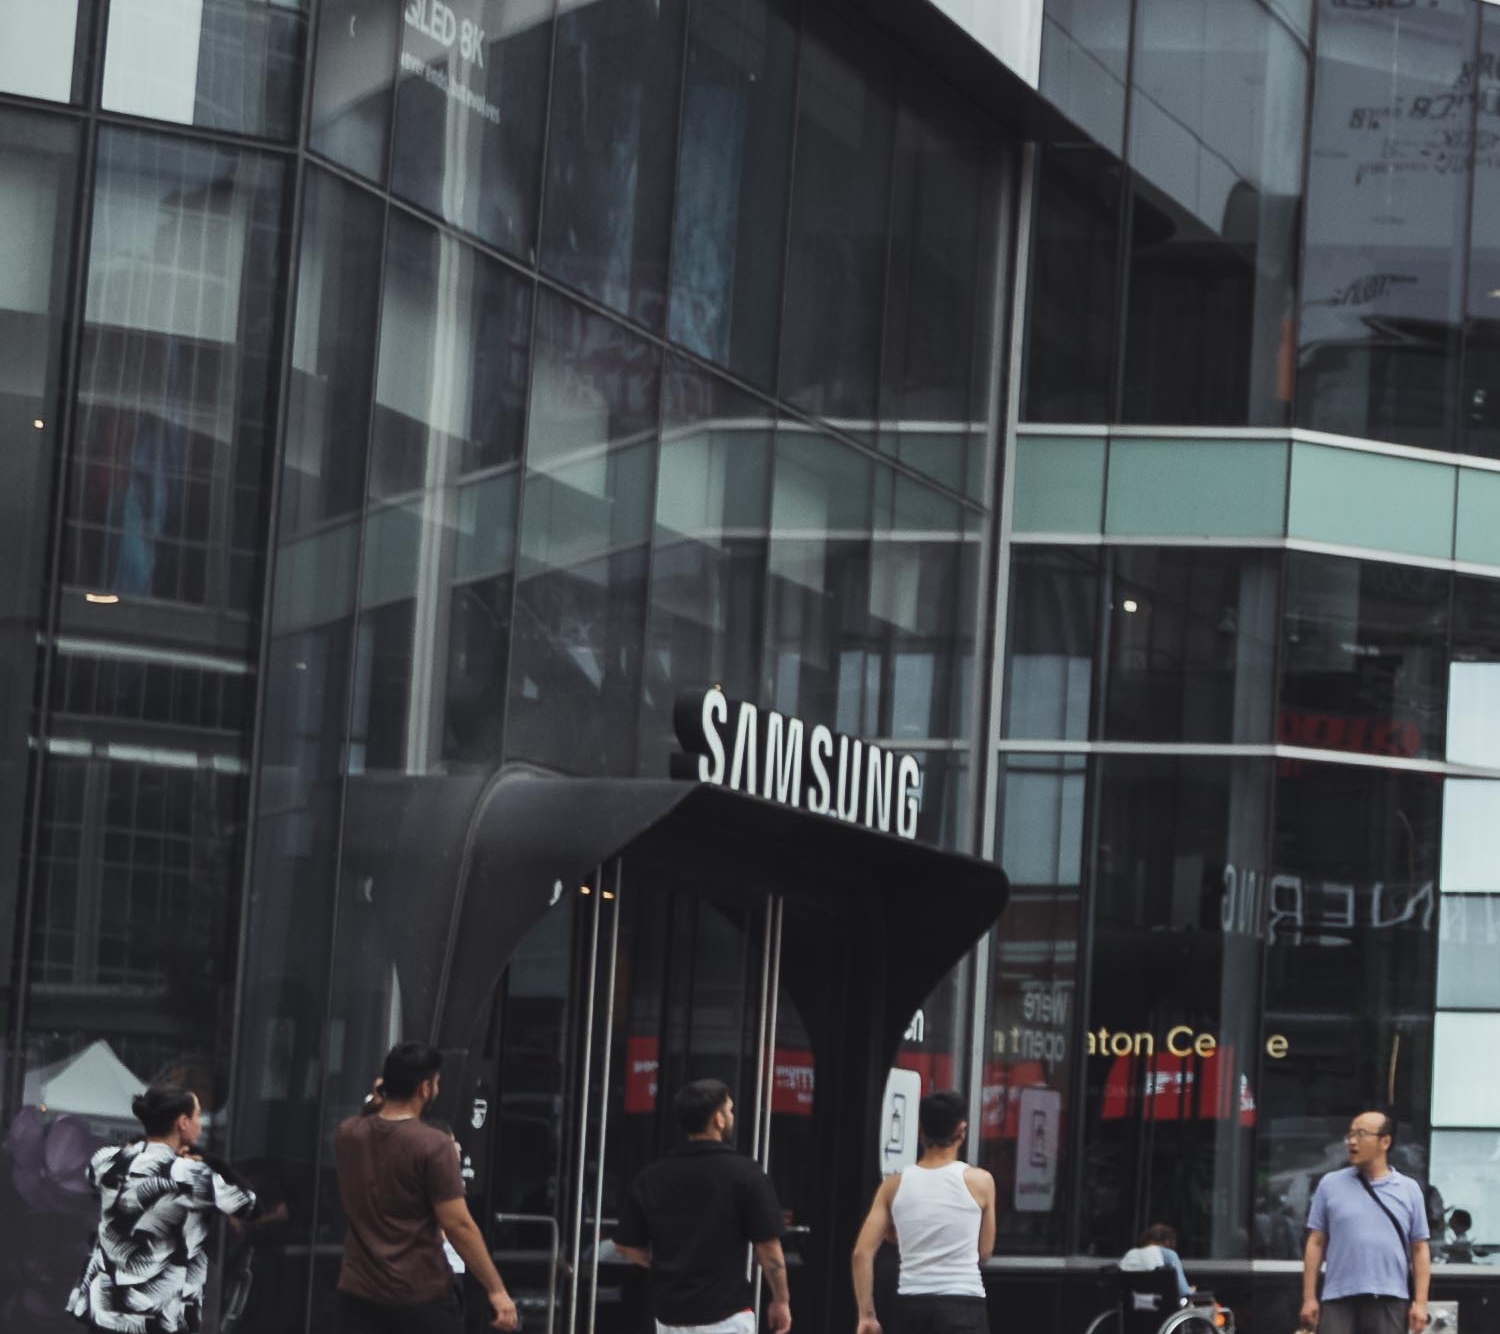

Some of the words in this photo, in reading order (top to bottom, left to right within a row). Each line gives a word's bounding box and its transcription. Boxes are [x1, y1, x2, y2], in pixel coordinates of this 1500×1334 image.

[460, 17, 485, 67] 8K
[698, 688, 919, 840] SAMSUNG
[1087, 1026, 1154, 1057] aton
